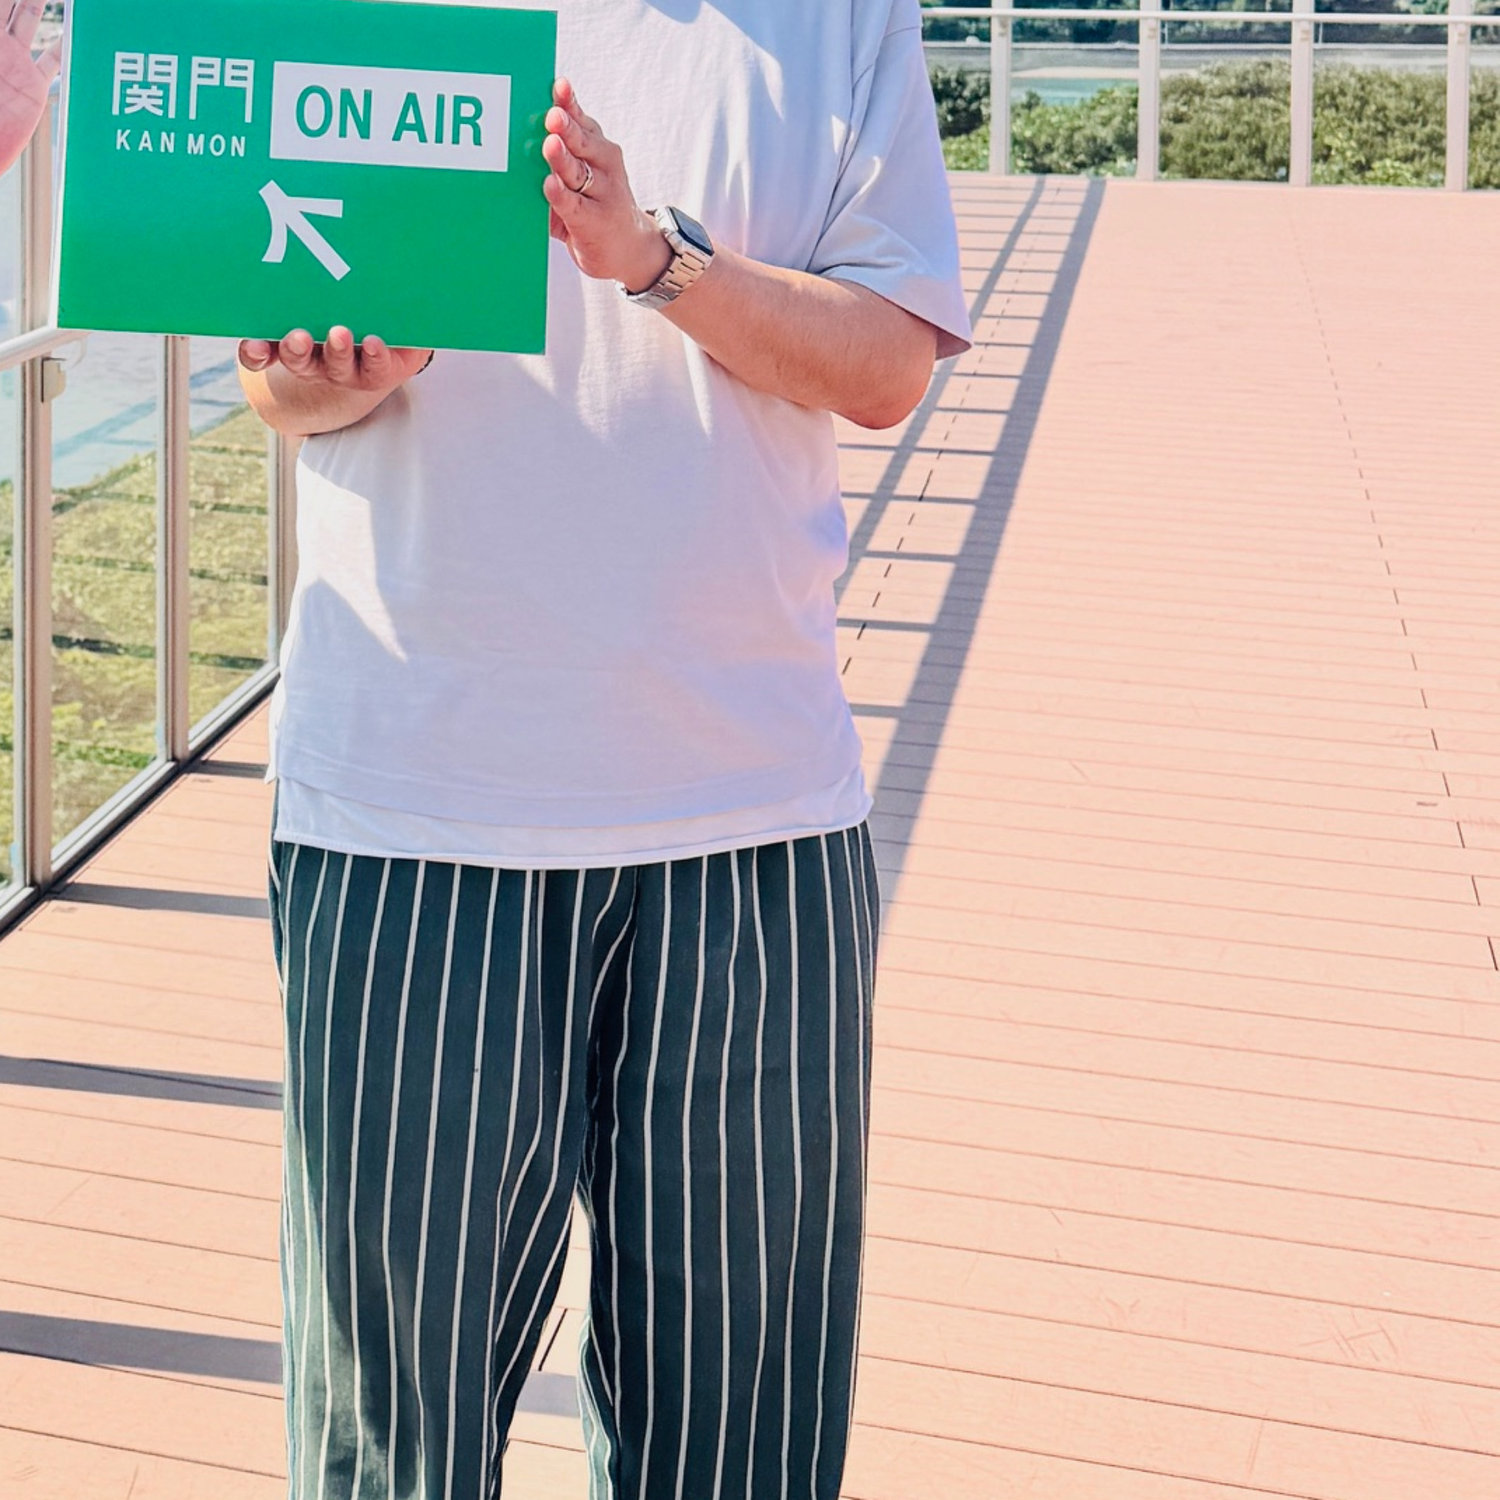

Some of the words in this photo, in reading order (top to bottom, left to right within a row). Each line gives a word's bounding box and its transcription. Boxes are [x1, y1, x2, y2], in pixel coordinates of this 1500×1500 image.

[111, 51, 255, 123] 関門
[296, 85, 373, 140] ON
[391, 92, 483, 147] AIR
